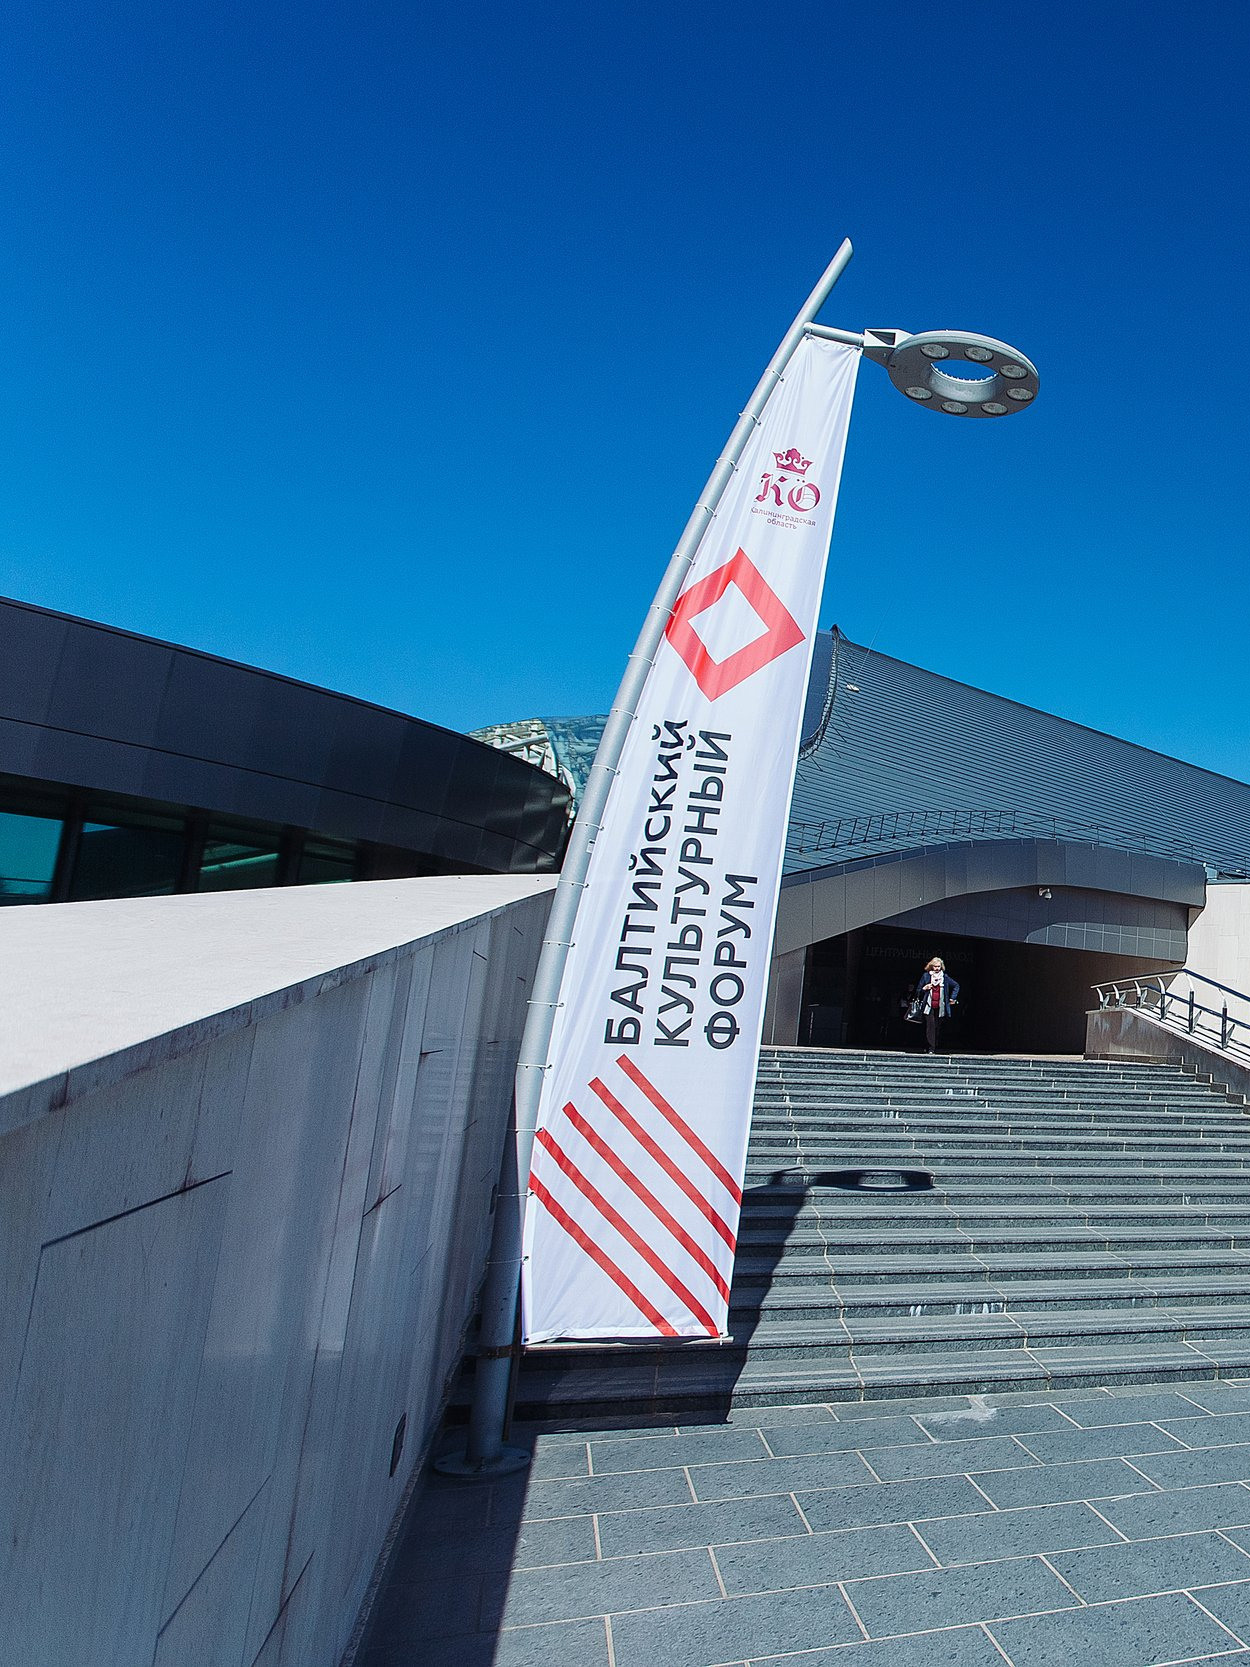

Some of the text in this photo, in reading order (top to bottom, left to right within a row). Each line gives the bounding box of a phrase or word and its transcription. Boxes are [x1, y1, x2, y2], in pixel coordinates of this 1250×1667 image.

[767, 518, 797, 530] область
[604, 719, 689, 1046] БАЛТИЙСКИЙ
[654, 729, 732, 1047] КУЛЬТУРНЫЙ
[704, 873, 758, 1050] ФОРУМ
